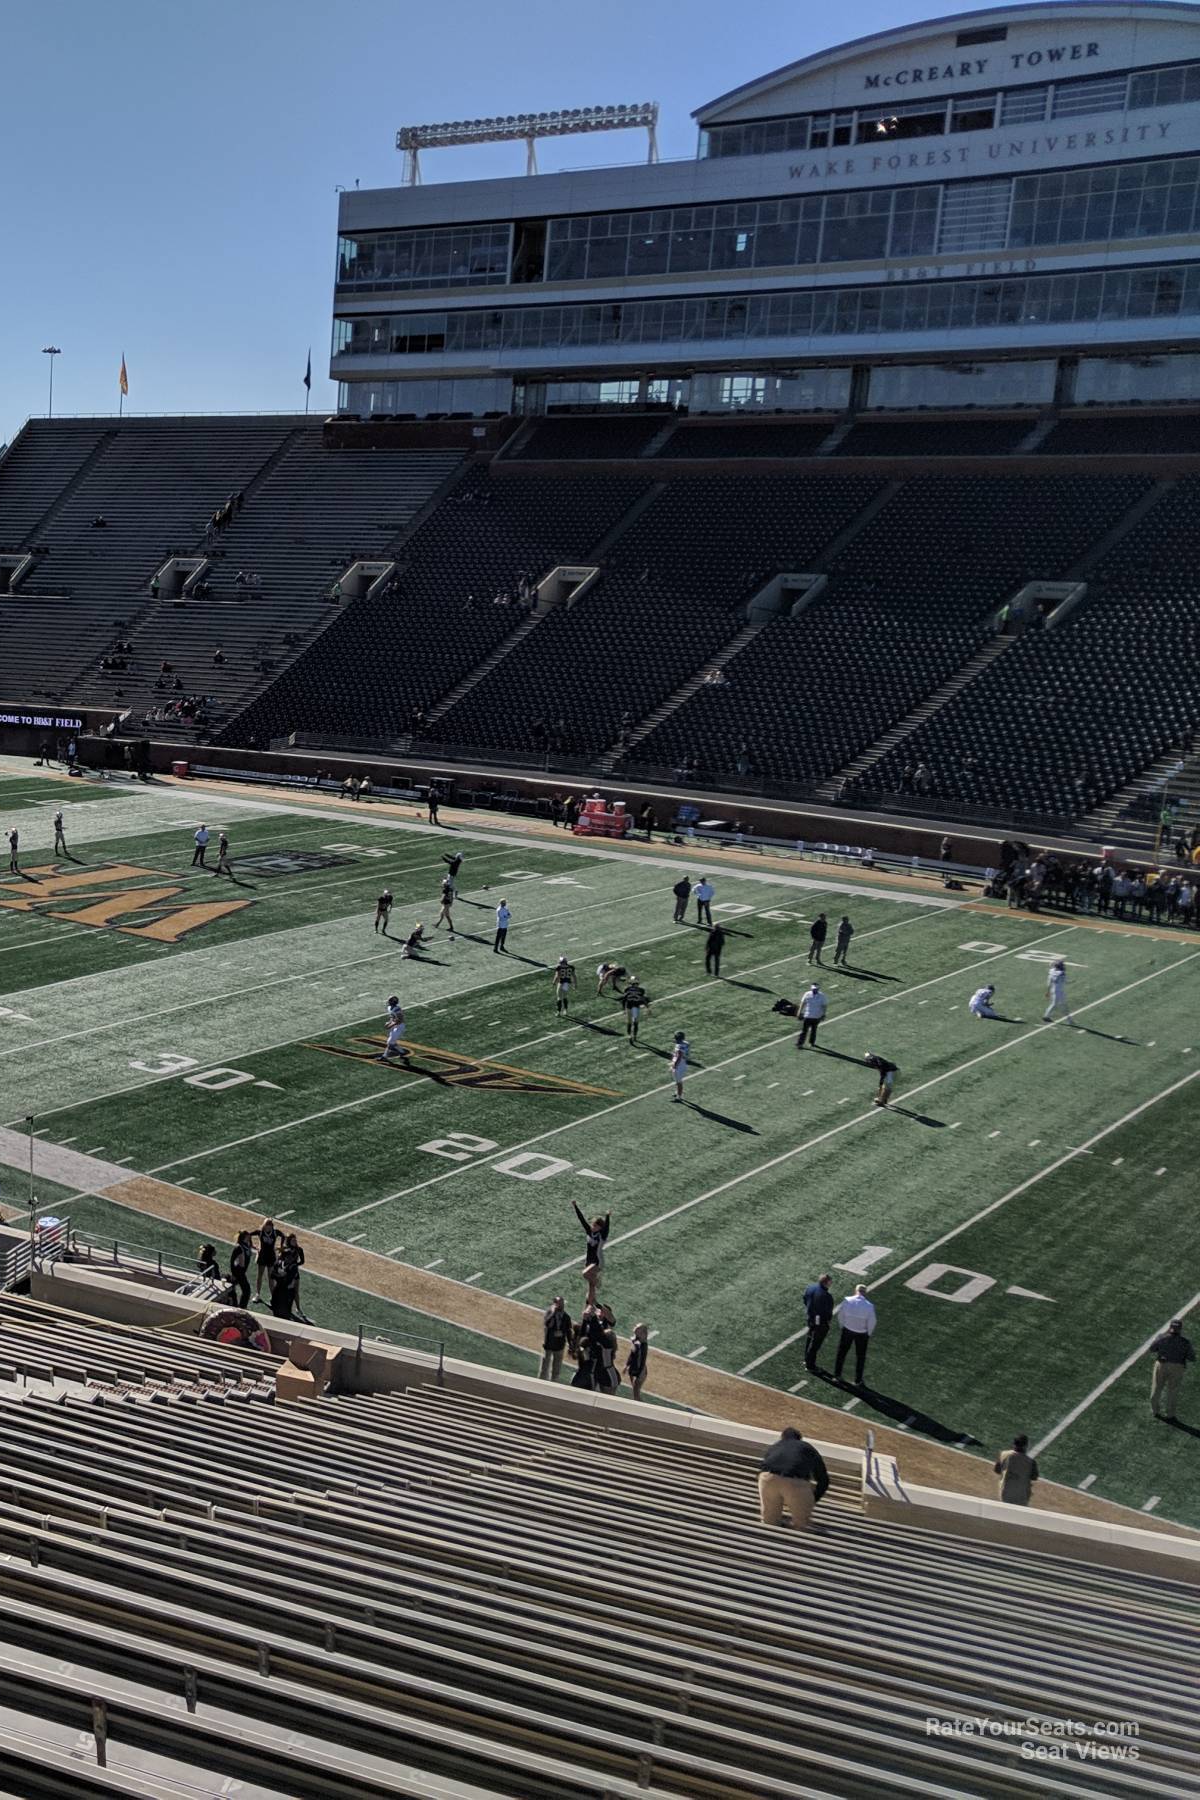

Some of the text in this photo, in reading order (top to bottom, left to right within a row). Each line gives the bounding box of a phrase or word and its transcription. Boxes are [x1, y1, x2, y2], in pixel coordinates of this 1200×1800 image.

[864, 42, 1101, 90] McCREARY TOWER
[787, 122, 1173, 180] WAKE FOREST UNIVERSITY
[966, 259, 1037, 276] FIELD
[21, 715, 32, 724] TO
[33, 716, 53, 726] BB&T
[55, 718, 83, 729] FIELD
[129, 1053, 256, 1090] 30
[415, 1133, 574, 1181] 20
[831, 1245, 998, 1304] 10
